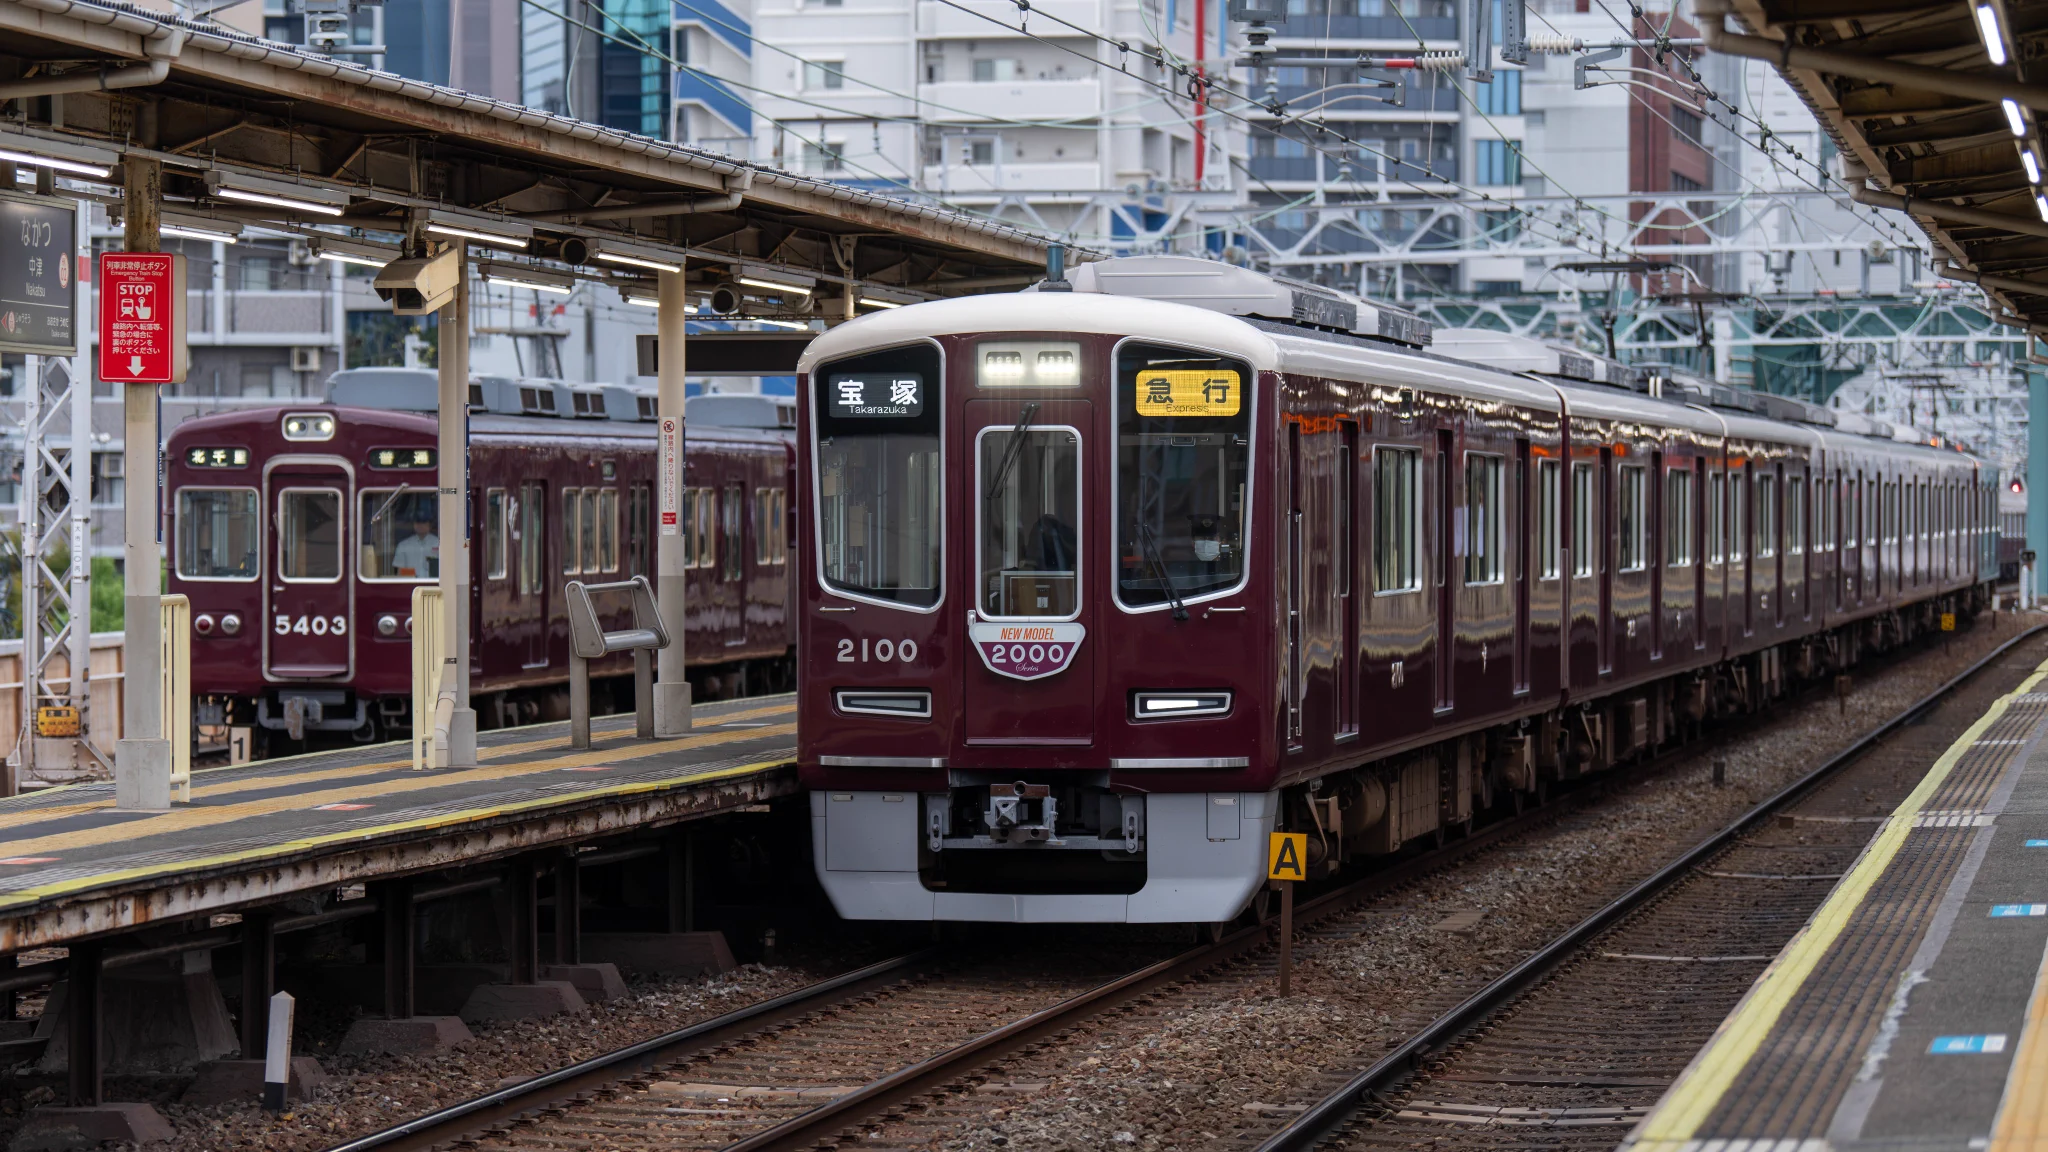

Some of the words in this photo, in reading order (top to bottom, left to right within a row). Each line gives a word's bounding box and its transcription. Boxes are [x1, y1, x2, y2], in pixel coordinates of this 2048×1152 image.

[21, 216, 51, 248] なかつ
[29, 256, 43, 277] 中津
[106, 261, 167, 270] 列車非常停止ボタン
[26, 282, 46, 297] Nakatsu
[119, 284, 153, 295] STOP
[112, 330, 153, 338] 緊急の場合に
[112, 338, 153, 347] 裏のボタンを
[112, 346, 160, 354] 押してください
[838, 379, 918, 405] 宝塚
[1145, 378, 1230, 403] 急行
[849, 405, 907, 414] Takarazuka
[1165, 404, 1210, 413] Express
[274, 615, 347, 636] 5403
[1000, 628, 1022, 640] NEW
[1023, 628, 1055, 640] MODEL
[836, 638, 918, 662] 2100
[992, 644, 1064, 663] 2000
[1015, 661, 1039, 673] Series
[233, 736, 244, 760] 1
[1272, 837, 1302, 876] A
